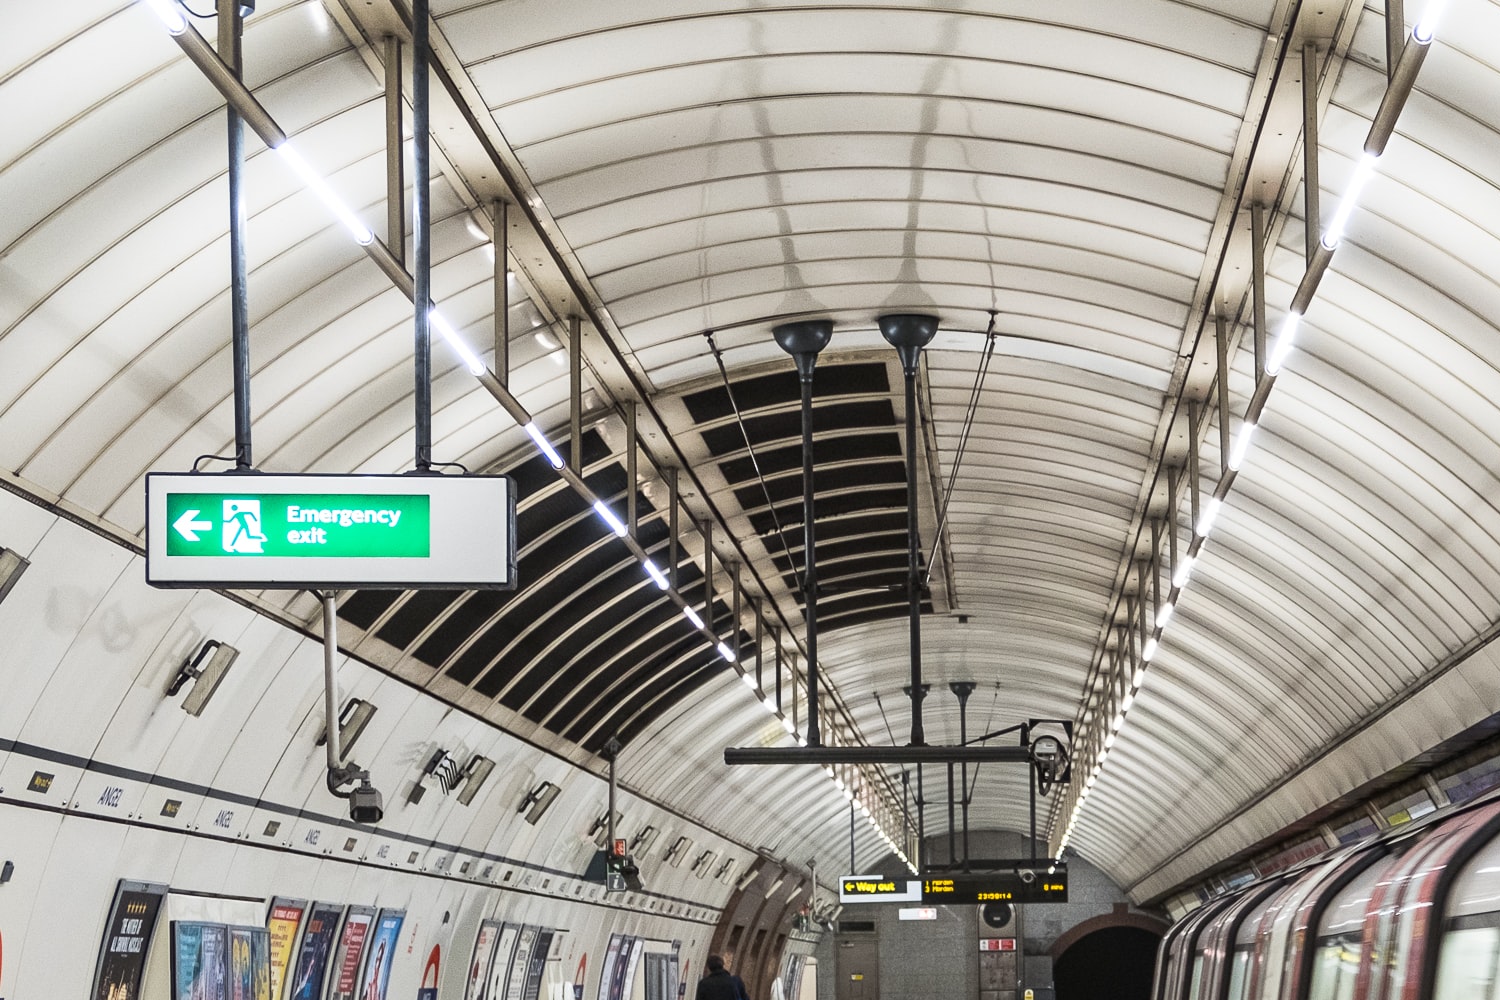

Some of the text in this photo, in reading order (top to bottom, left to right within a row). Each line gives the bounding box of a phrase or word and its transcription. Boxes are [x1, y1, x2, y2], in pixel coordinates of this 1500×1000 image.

[286, 505, 401, 528] Emergency
[286, 526, 328, 544] exit
[96, 786, 123, 807] ANGEL
[213, 810, 233, 828] ANGEL
[855, 882, 896, 893] Way out
